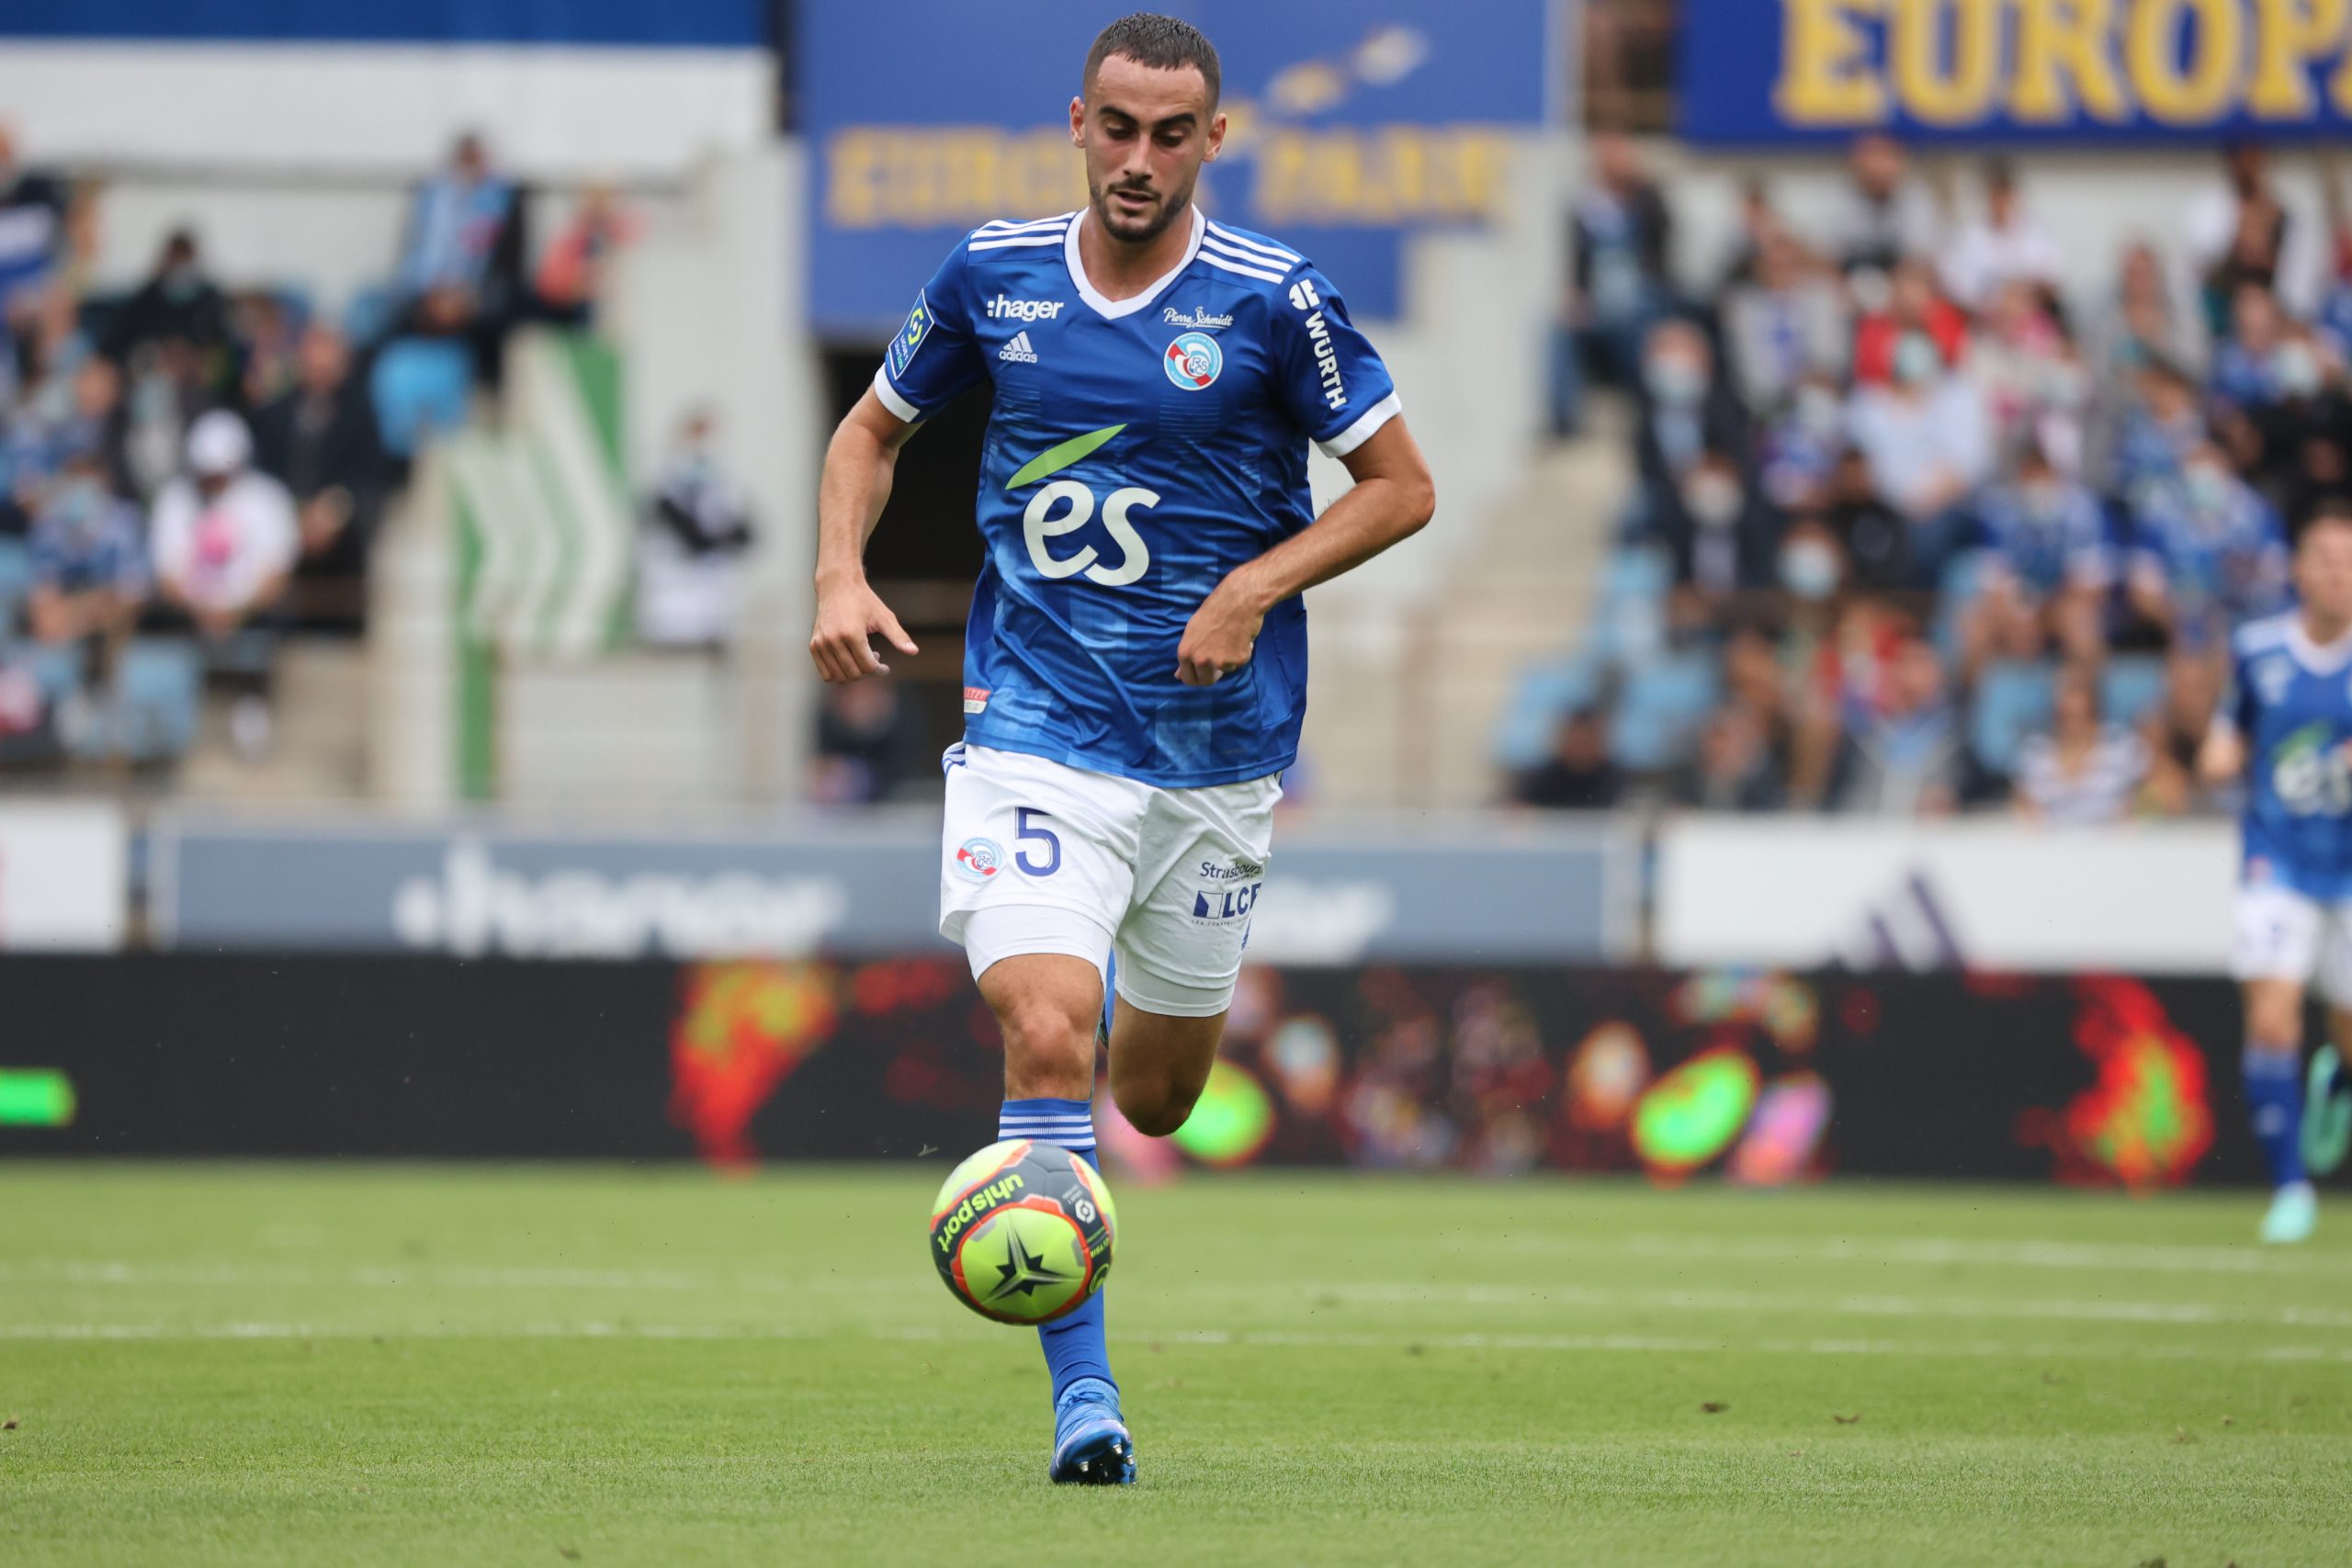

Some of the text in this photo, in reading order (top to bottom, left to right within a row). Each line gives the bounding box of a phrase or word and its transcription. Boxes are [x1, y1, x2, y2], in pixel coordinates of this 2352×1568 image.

[1771, 0, 2352, 126] EUROP
[1192, 306, 1234, 328] Schmidt
[999, 350, 1038, 364] adidas
[1023, 479, 1161, 587] es
[1014, 807, 1061, 877] 5
[938, 1174, 1024, 1253] uhlsport
